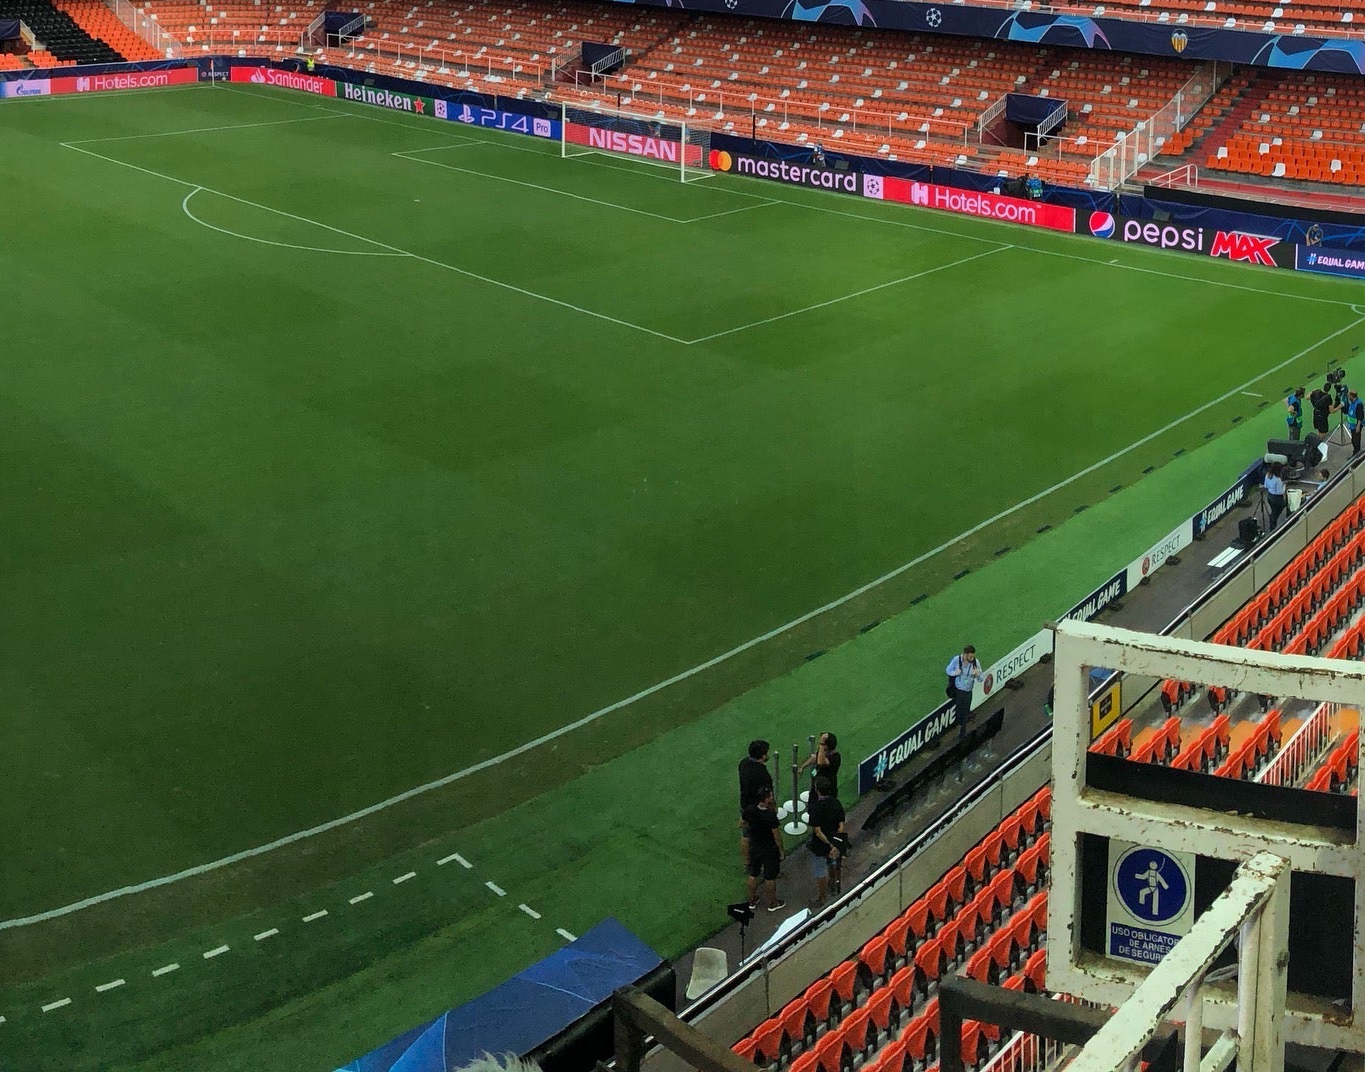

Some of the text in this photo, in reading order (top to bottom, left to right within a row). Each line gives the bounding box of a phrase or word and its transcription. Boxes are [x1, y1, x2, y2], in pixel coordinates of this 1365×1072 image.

[95, 74, 168, 91] Hotels.com
[267, 69, 324, 94] Santander
[344, 83, 412, 112] Heineken
[481, 109, 549, 134] PS4 Pro
[589, 127, 676, 161] NISSAN
[737, 156, 856, 193] mastercard
[935, 187, 1036, 224] Hotels.com
[1124, 220, 1283, 267] pepsi MAX
[1306, 253, 1365, 270] #EQUAL GAM
[1199, 484, 1245, 533] #EQUAL GAME
[1151, 534, 1181, 567] RESPECT
[1097, 579, 1121, 609] GAME
[996, 644, 1036, 684] RESPECT
[873, 705, 957, 782] #EQUAL GAME
[1112, 926, 1130, 937] USO
[1129, 939, 1140, 948] DE
[1119, 945, 1130, 955] DE
